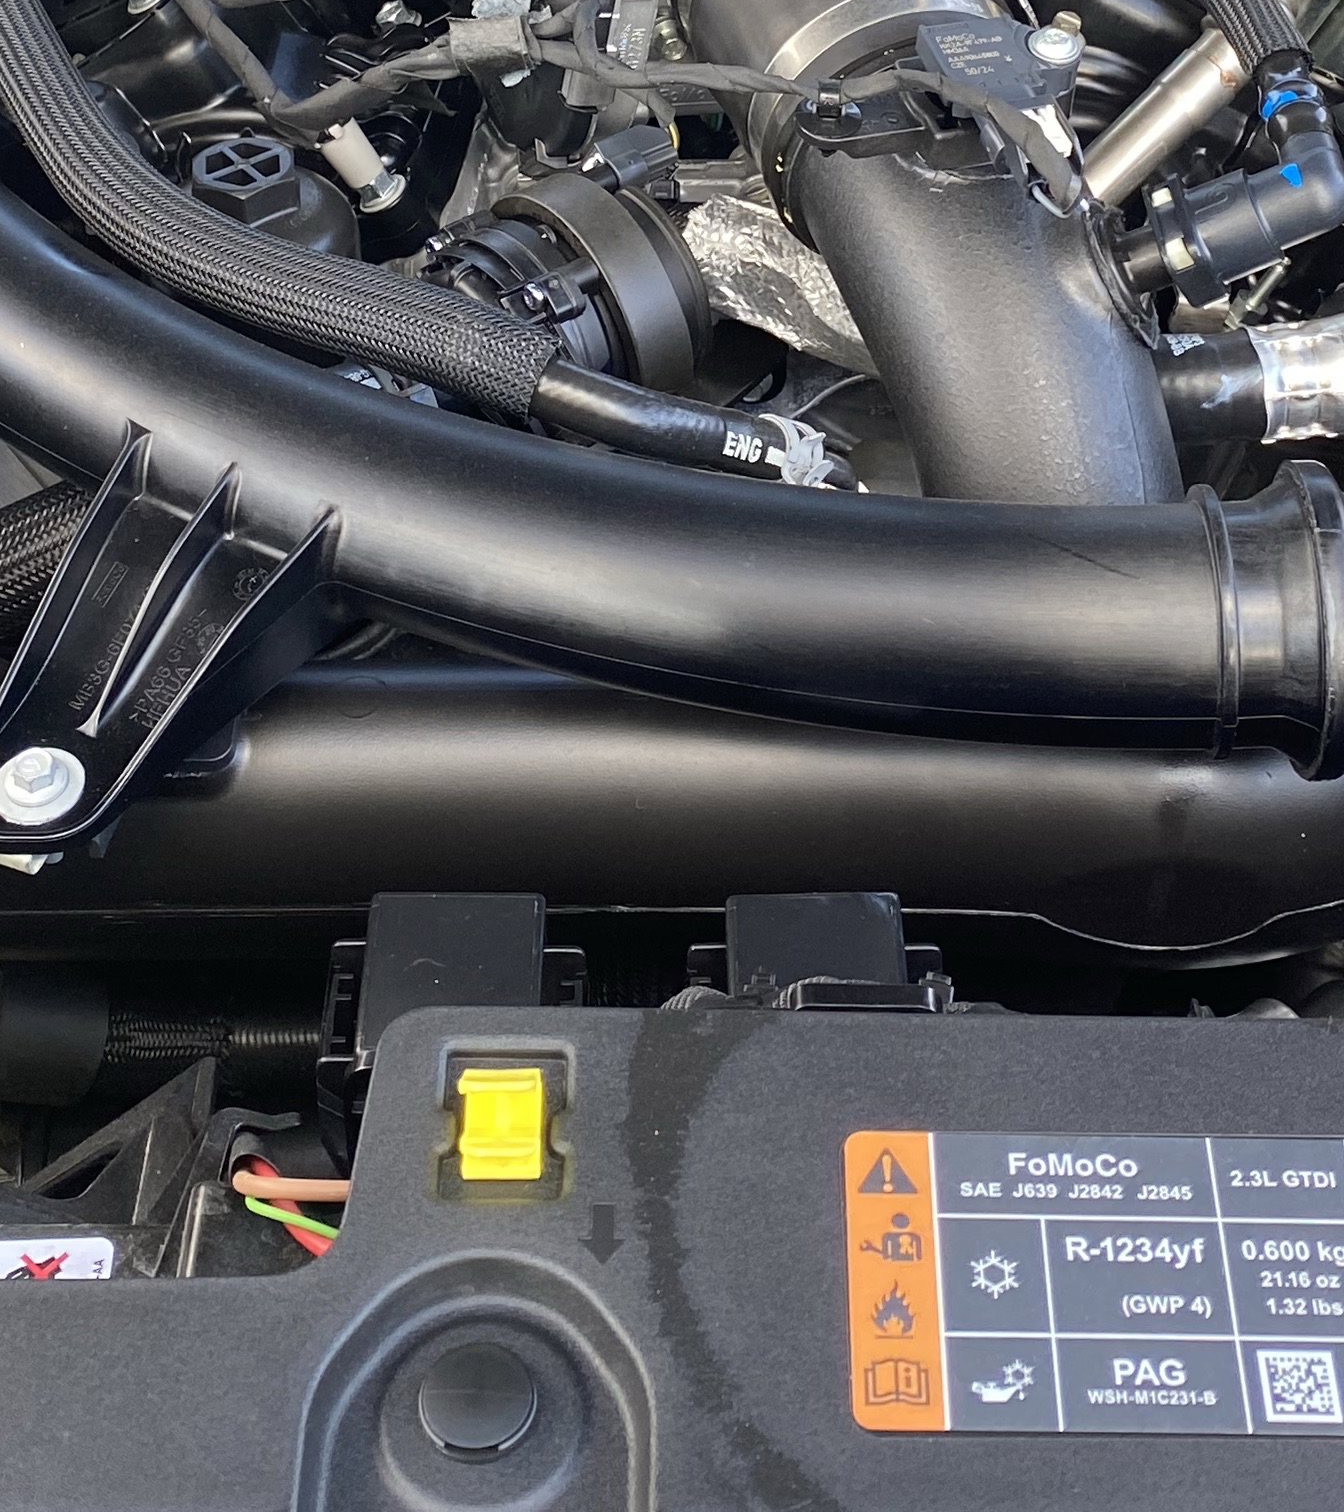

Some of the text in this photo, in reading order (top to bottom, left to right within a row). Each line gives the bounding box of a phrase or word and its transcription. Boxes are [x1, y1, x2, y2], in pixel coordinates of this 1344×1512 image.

[721, 430, 764, 464] ENG
[1008, 1152, 1138, 1178] FoMoCo
[1229, 1169, 1337, 1189] 2.3L GTDI
[960, 1181, 1193, 1201] SAE J639 J2842 J2845
[1065, 1235, 1206, 1270] R-1234yf
[1241, 1239, 1311, 1262] 0.600
[1259, 1270, 1342, 1289] 21.16 oz
[1121, 1295, 1214, 1320] (GWP 4)
[1266, 1297, 1344, 1317] 1.32 lbs
[1112, 1358, 1187, 1386] PAG
[1086, 1389, 1218, 1406] WSH-M1C231-B
